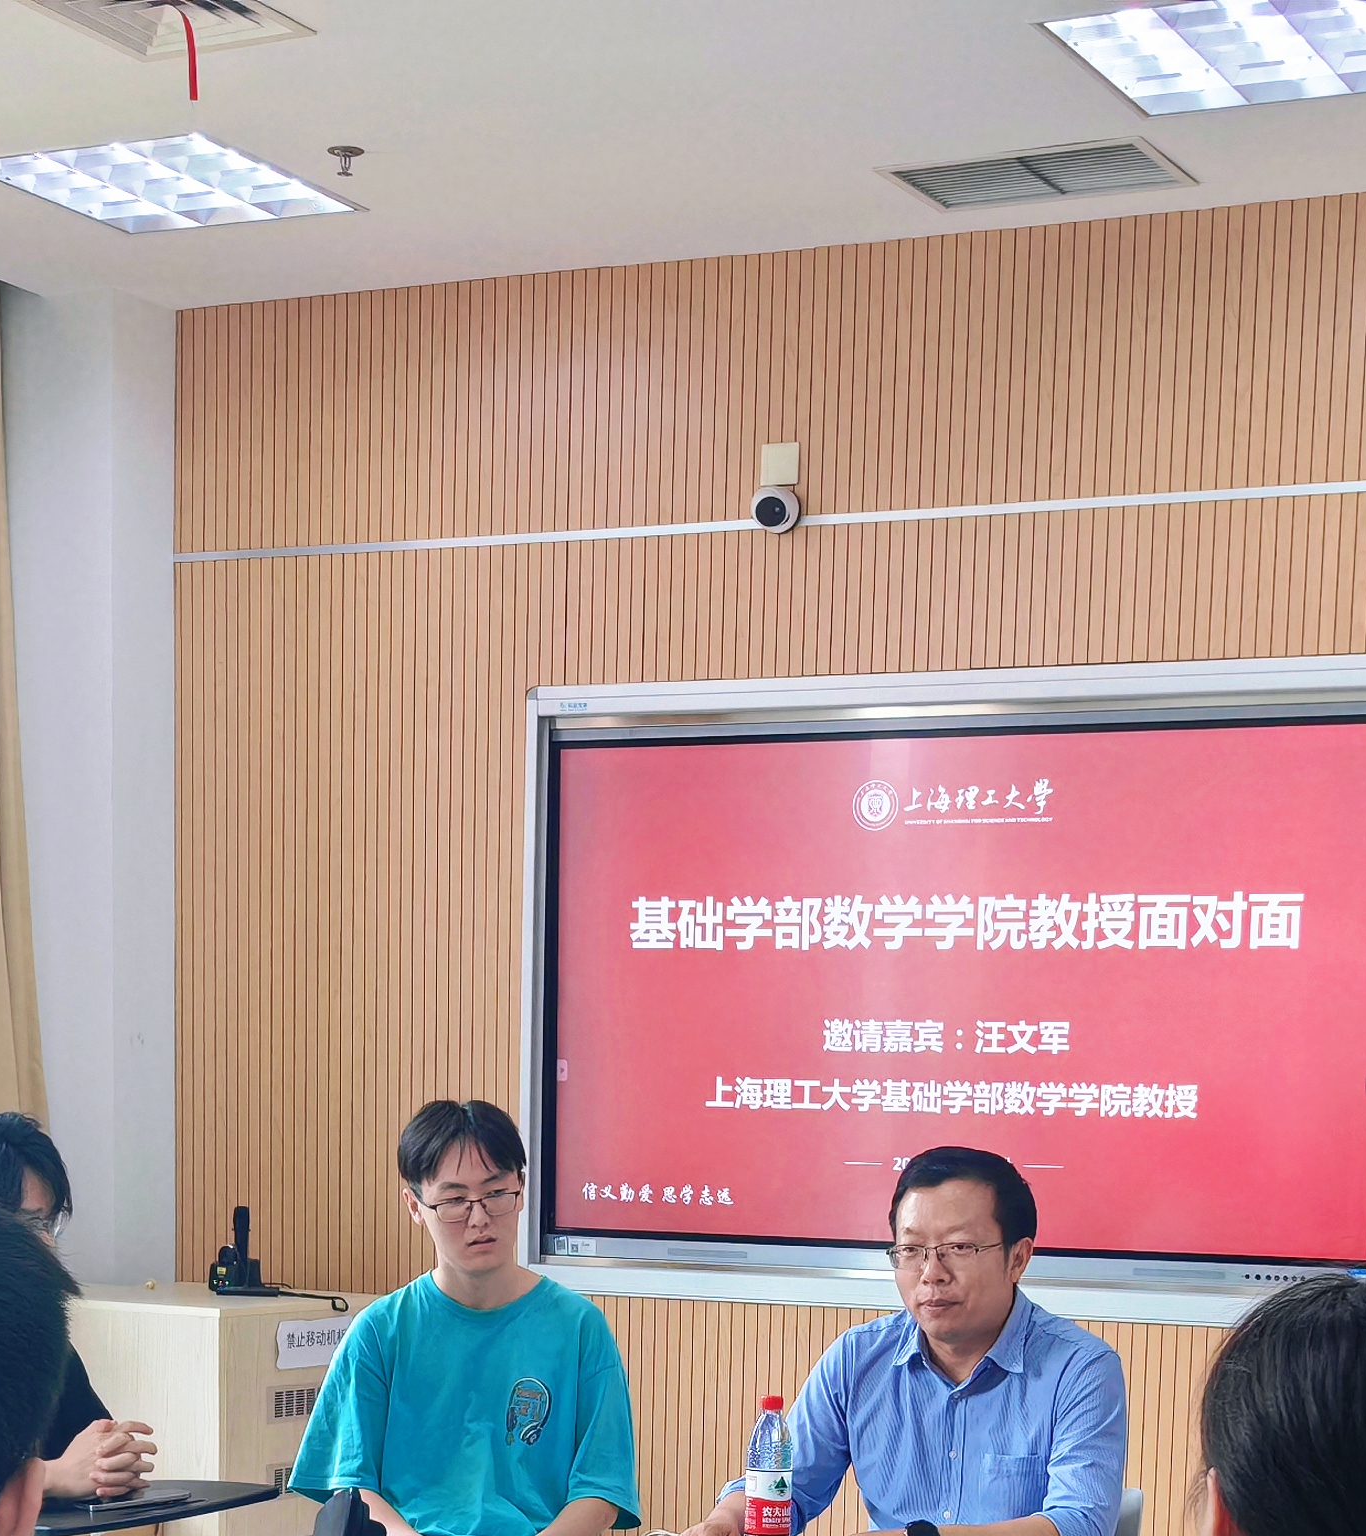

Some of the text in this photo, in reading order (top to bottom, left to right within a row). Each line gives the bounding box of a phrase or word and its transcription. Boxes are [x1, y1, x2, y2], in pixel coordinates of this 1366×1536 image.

[630, 890, 1305, 951] 基础学部数学学院教授面对面
[822, 1018, 1070, 1055] 邀请嘉宾：汪文军
[705, 1076, 1198, 1119] 上海理工大学基础学部数学学院教授
